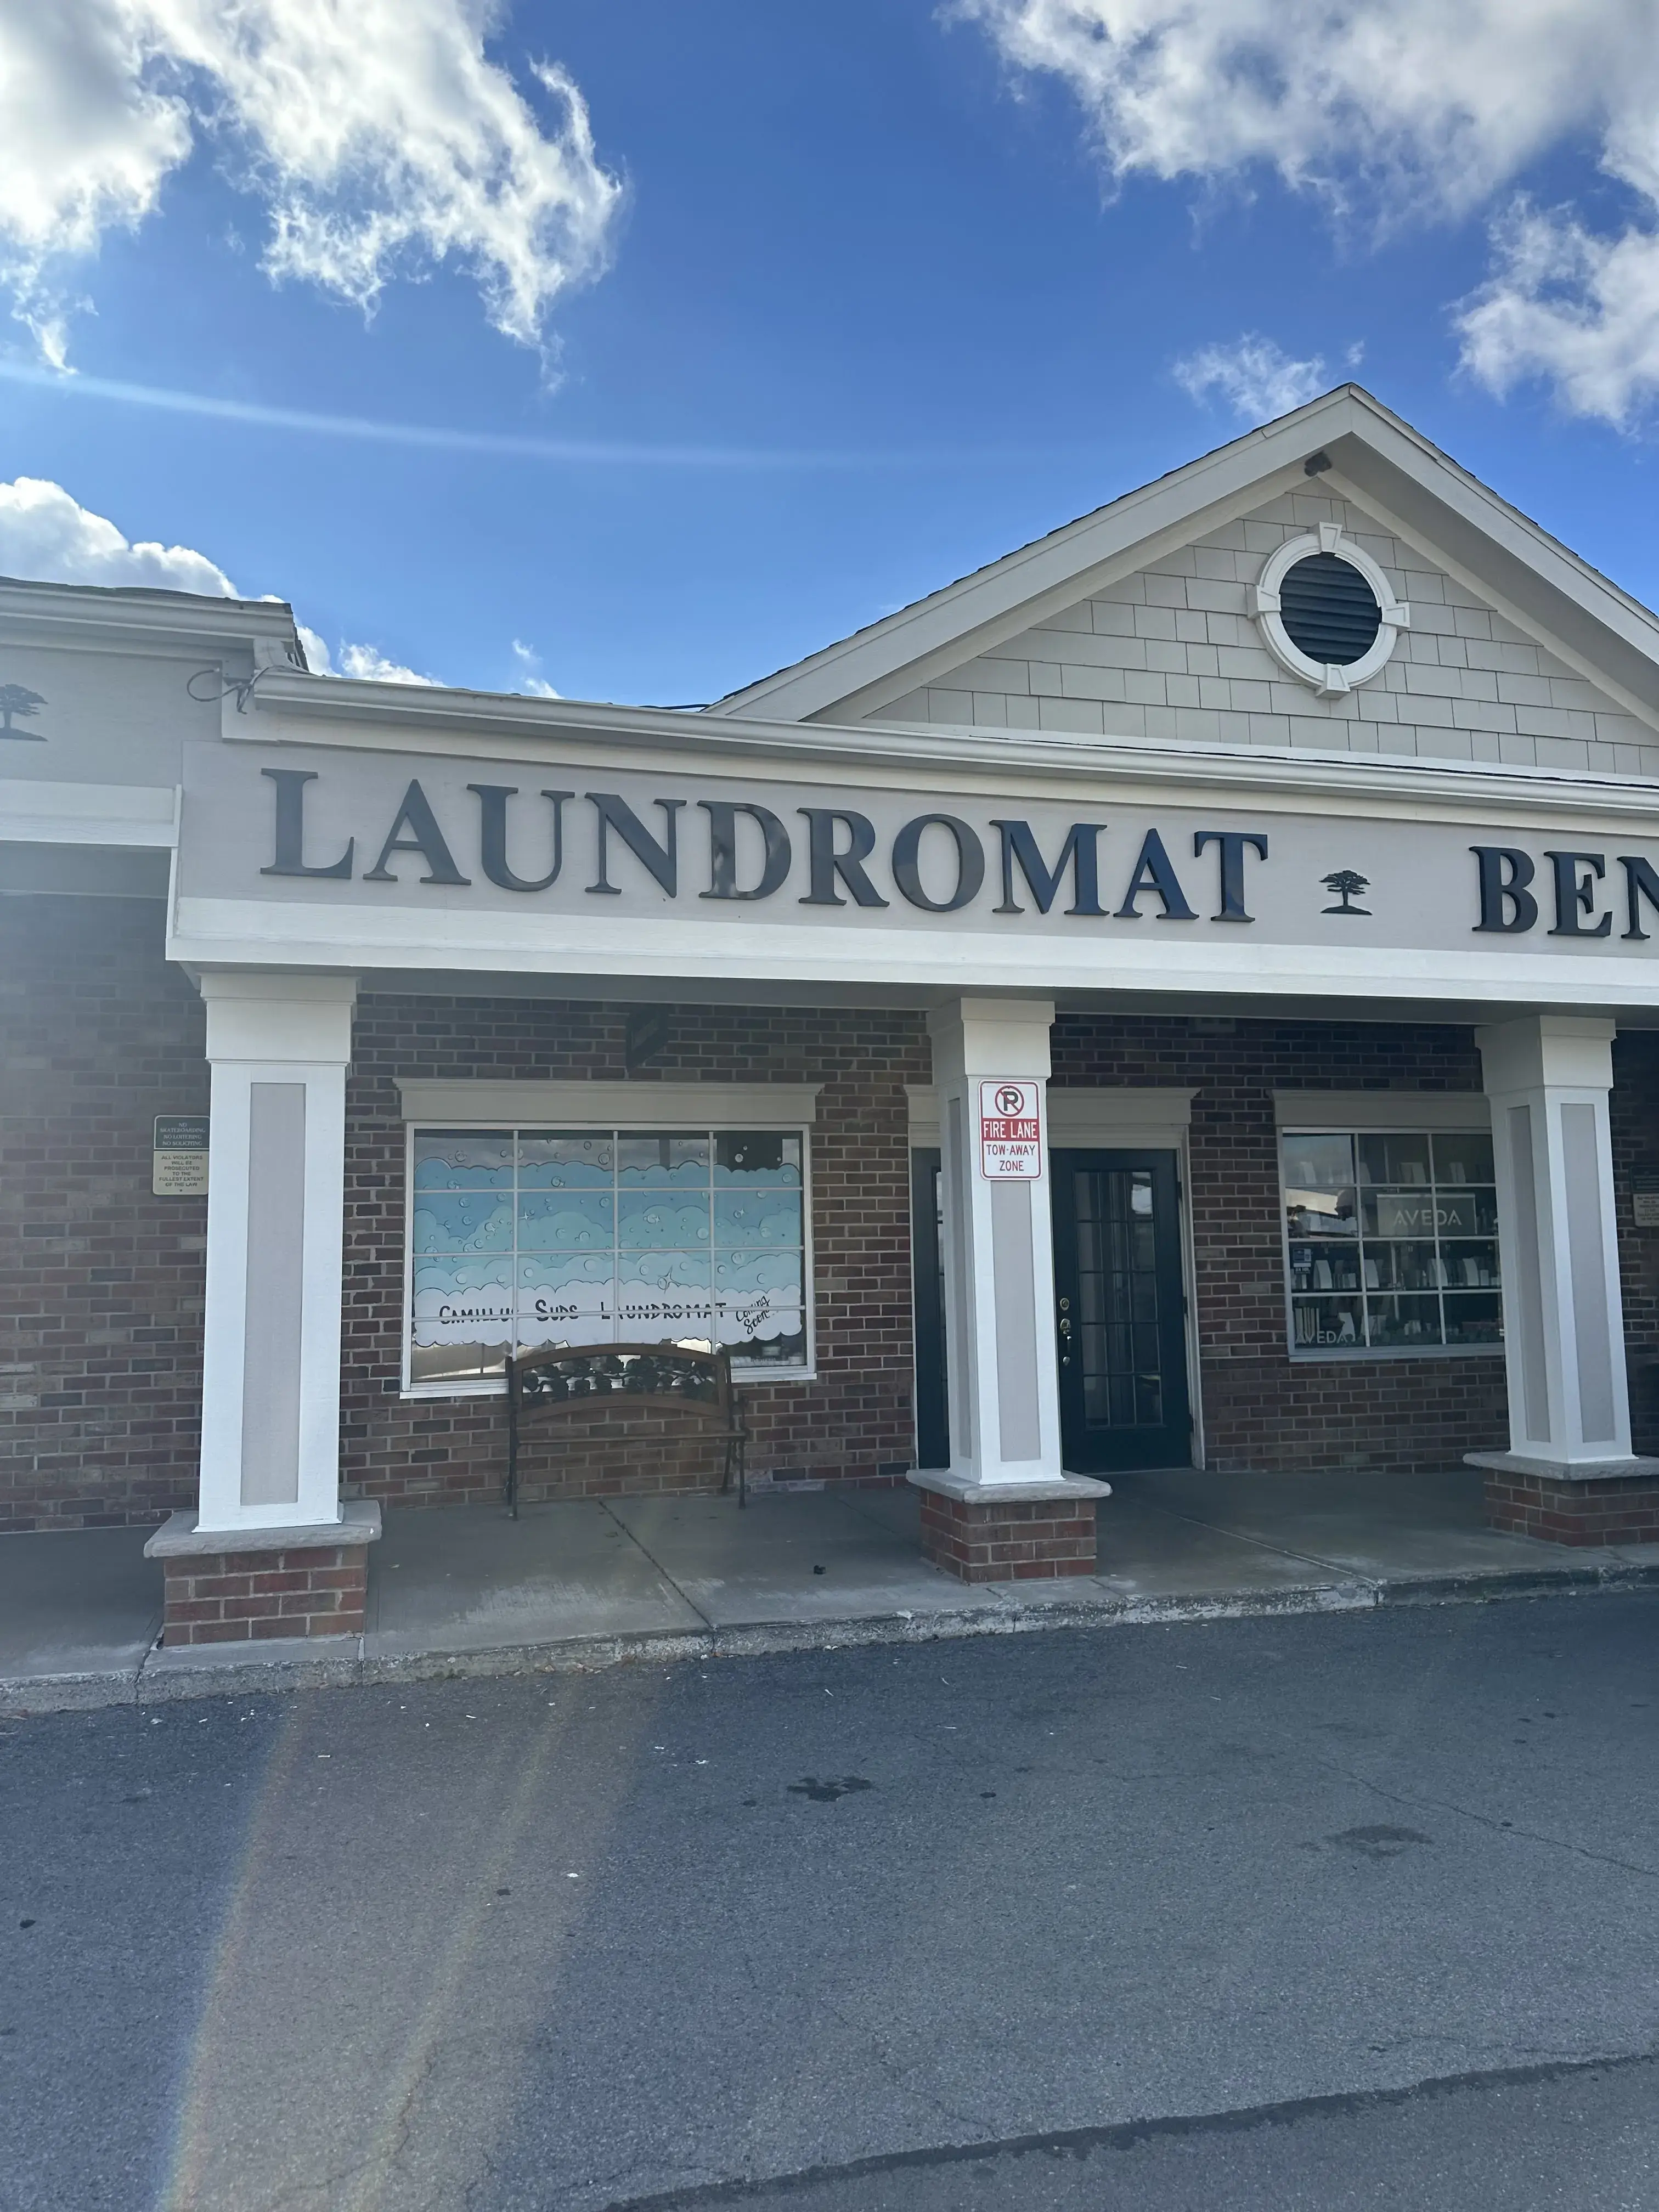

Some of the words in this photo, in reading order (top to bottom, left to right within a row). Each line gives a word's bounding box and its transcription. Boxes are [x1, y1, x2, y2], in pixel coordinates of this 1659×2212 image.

[260, 768, 1268, 923] LAUNDROMAT
[984, 1121, 1006, 1138] FIRE
[1010, 1121, 1037, 1139] LANE
[986, 1144, 1036, 1156] TOW-AWAY
[1000, 1160, 1024, 1172] ZONE
[1393, 1209, 1462, 1226] AVEDA
[1295, 1330, 1348, 1344] AVEDA
